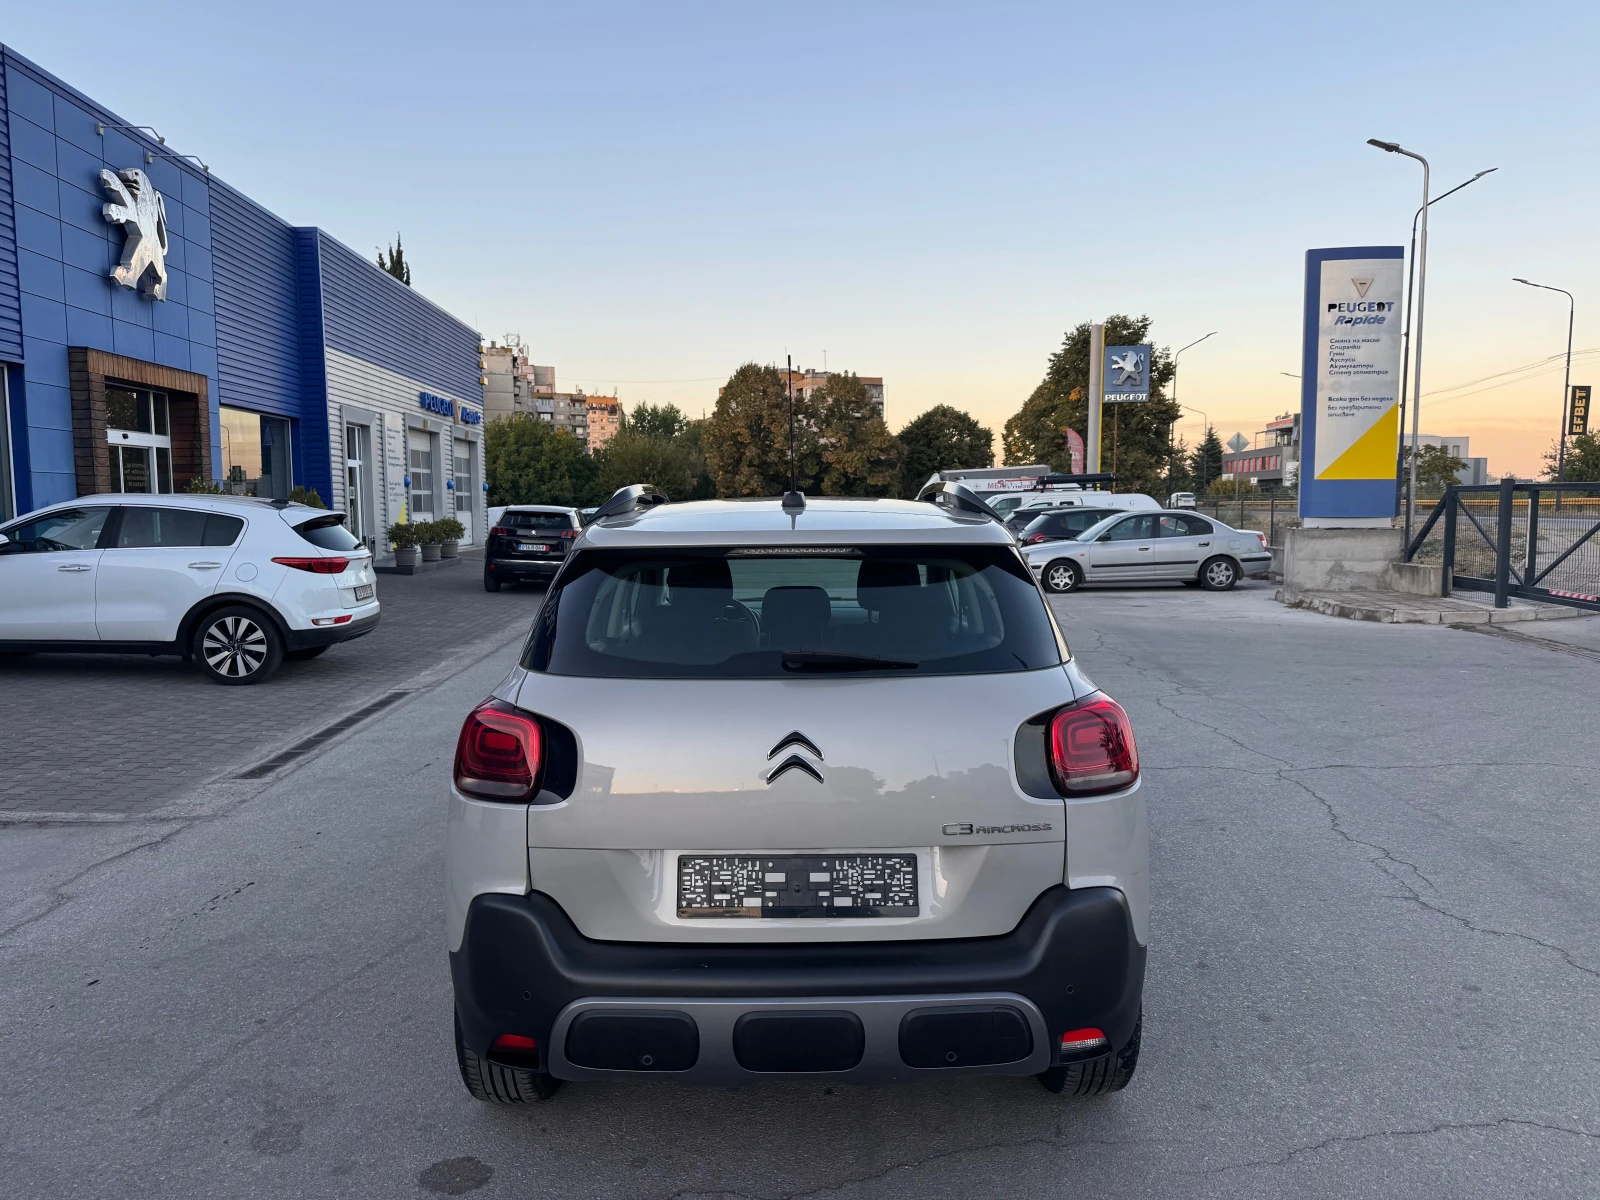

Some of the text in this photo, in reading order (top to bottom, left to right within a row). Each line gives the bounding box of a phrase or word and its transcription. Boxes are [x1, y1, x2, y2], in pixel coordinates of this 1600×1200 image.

[1327, 301, 1395, 313] PEUGEOT
[1334, 314, 1386, 327] Rapide
[1104, 393, 1148, 401] PEUGEOT
[1572, 388, 1587, 432] EFBET
[942, 822, 1053, 836] C3 AIRCROSS
